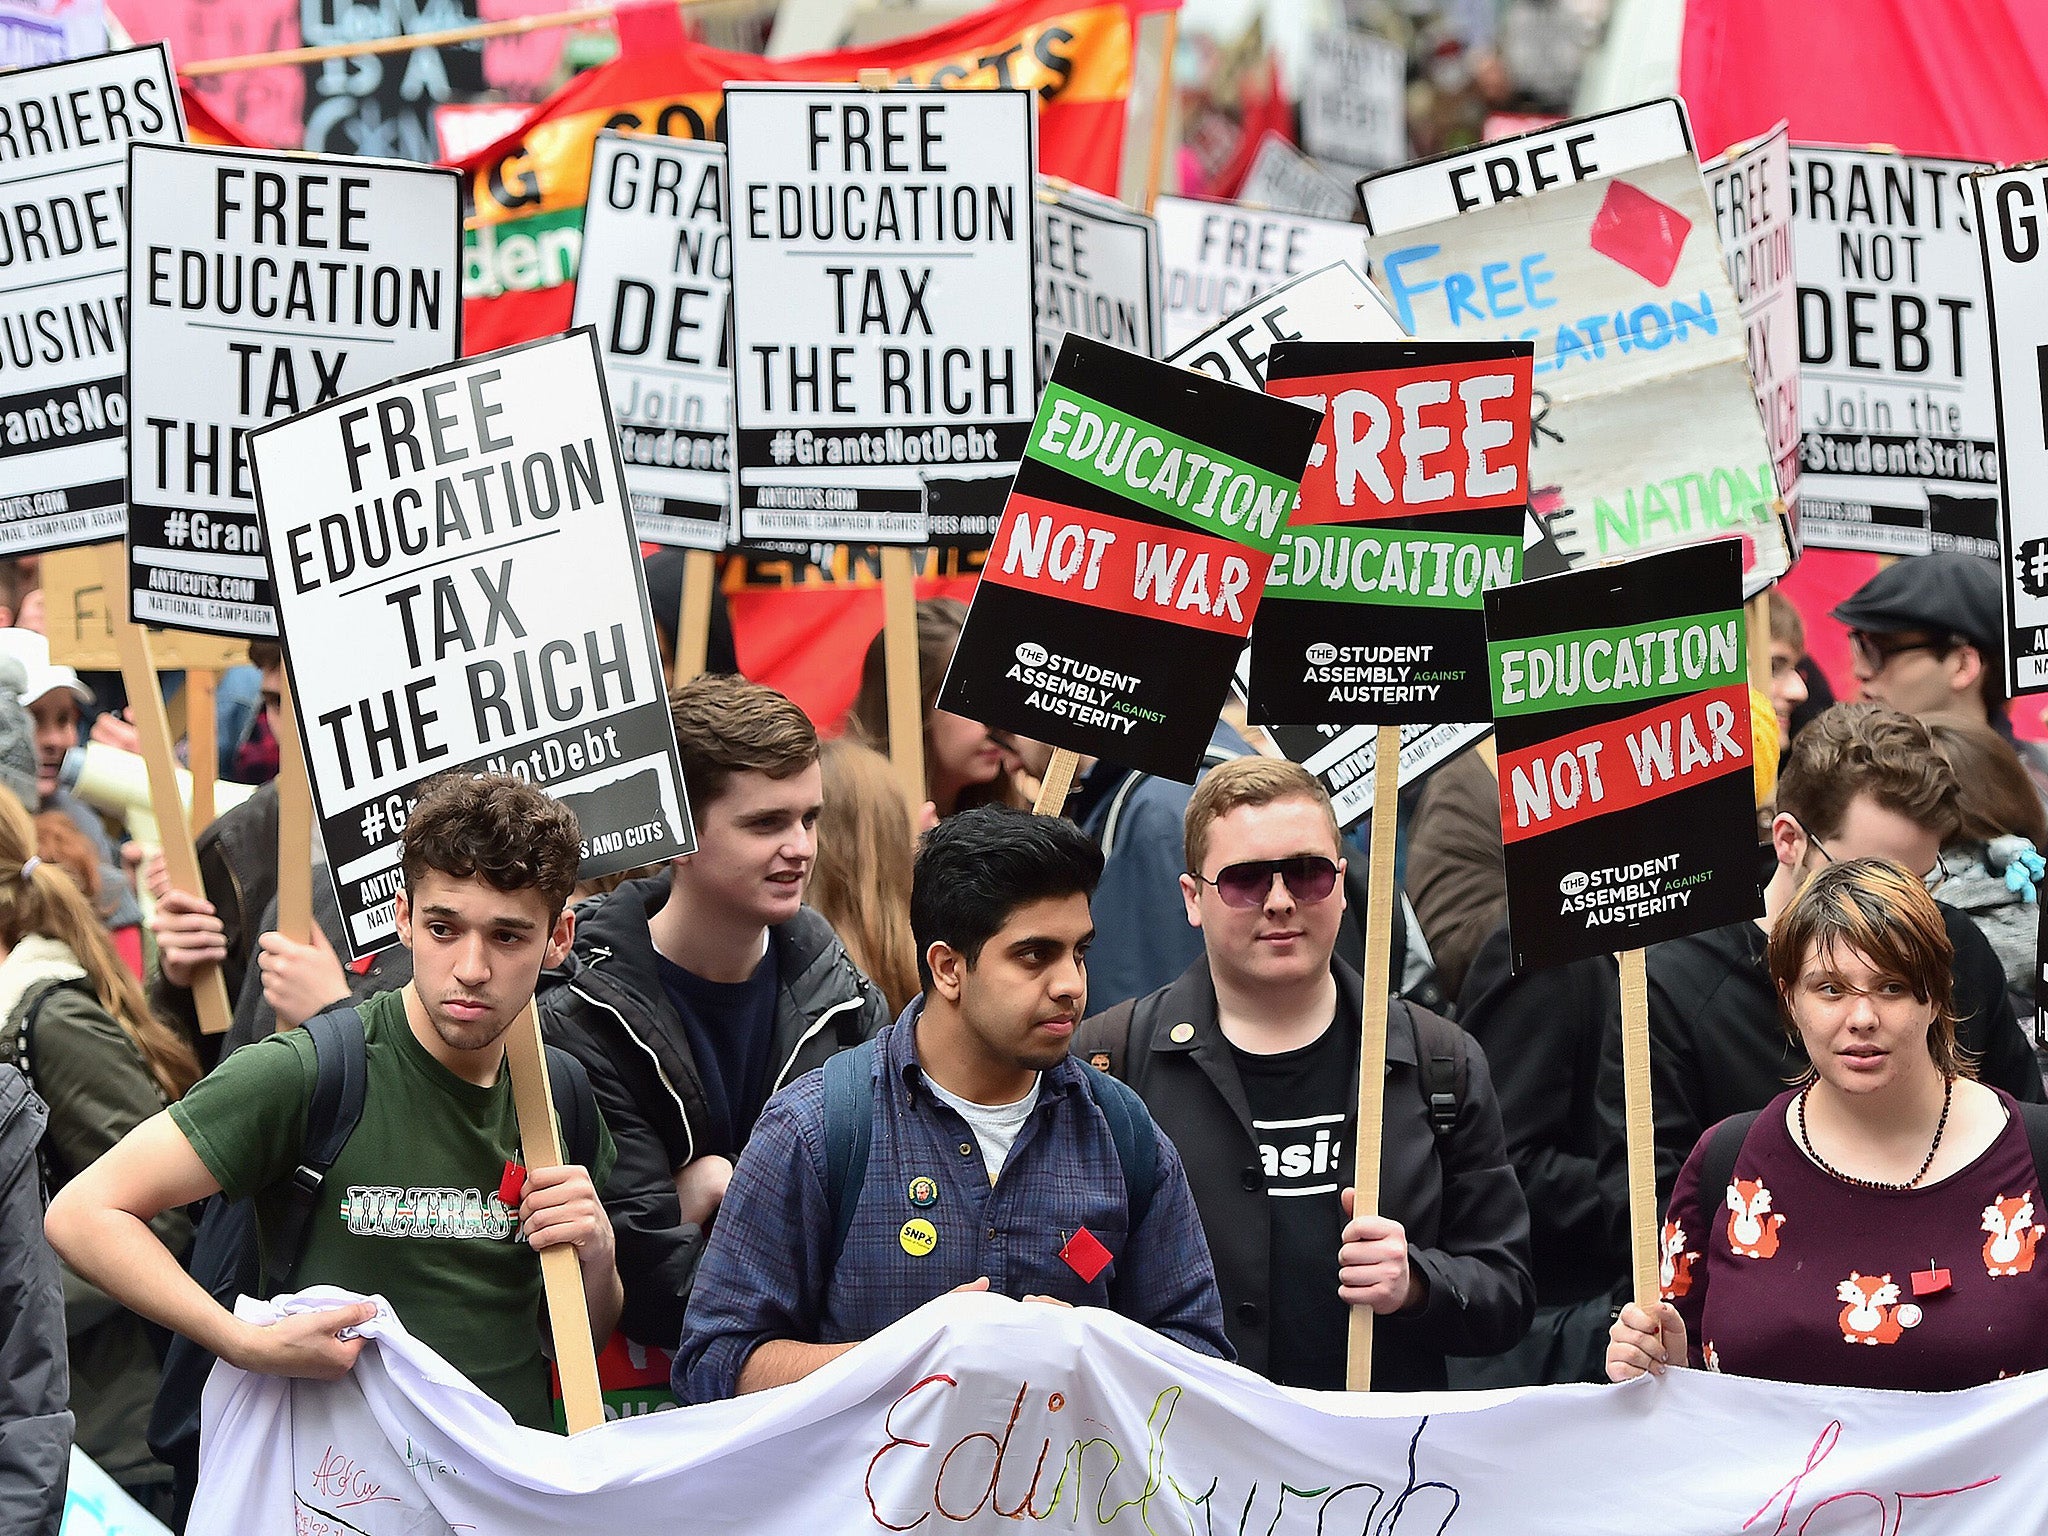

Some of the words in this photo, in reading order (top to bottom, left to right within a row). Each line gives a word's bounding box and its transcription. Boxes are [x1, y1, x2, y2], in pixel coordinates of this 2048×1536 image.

[809, 104, 947, 172] FREE
[217, 167, 371, 252] FREE
[749, 184, 1014, 242] EDUCATION
[1200, 214, 1307, 275] FREE
[1840, 231, 1922, 285] NOT
[149, 247, 442, 331] EDUCATION
[826, 267, 934, 336] TAX
[1383, 242, 1558, 338] FREE
[610, 280, 728, 368] DE
[1796, 286, 1973, 378] DEBT
[229, 341, 348, 418] TAX
[752, 346, 857, 413] THE
[883, 347, 1016, 415] RICH
[1816, 387, 1894, 430] Join
[1909, 394, 1962, 436] the
[339, 369, 514, 493] FREE
[769, 425, 999, 465] #GrantsNotDebt
[757, 487, 859, 510] ANTICUTS.COM
[1038, 398, 1289, 540] EDUCATION
[286, 438, 605, 596] EDUCATION
[1594, 462, 1776, 551] NATION
[149, 567, 256, 602] ANTICUTS.COM
[1001, 511, 1117, 591] NOT
[1132, 541, 1252, 626] WAR
[1266, 533, 1515, 599] EDUCATION
[148, 595, 204, 618] NATIONAL
[207, 605, 271, 626] CAMPAIGN
[386, 558, 528, 670] TAX
[1020, 648, 1044, 663] THE
[1047, 653, 1142, 695] STUDENT
[1303, 665, 1411, 684] ASSEMBLY
[1413, 670, 1467, 682] AGAINST
[1309, 649, 1333, 660] THE
[1339, 645, 1434, 663] STUDENT
[1499, 620, 1739, 705] EDUCATION
[319, 676, 449, 792] THE
[465, 623, 636, 745] RICH
[1005, 663, 1114, 707] ASSEMBLY
[1112, 700, 1167, 725] AGAINST
[1024, 690, 1138, 736] AUSTERITY
[1328, 684, 1441, 703] AUSTERITY
[1510, 740, 1604, 828] NOT
[1626, 700, 1744, 788] WAR
[592, 832, 623, 856] AND
[625, 821, 664, 848] CUTS
[1560, 878, 1661, 915] ASSEMBLY
[1664, 871, 1713, 891] AGAINST
[1563, 877, 1586, 889] THE
[1590, 853, 1680, 887] STUDENT
[1585, 890, 1692, 929] AUSTERITY
[904, 1226, 926, 1241] SNP
